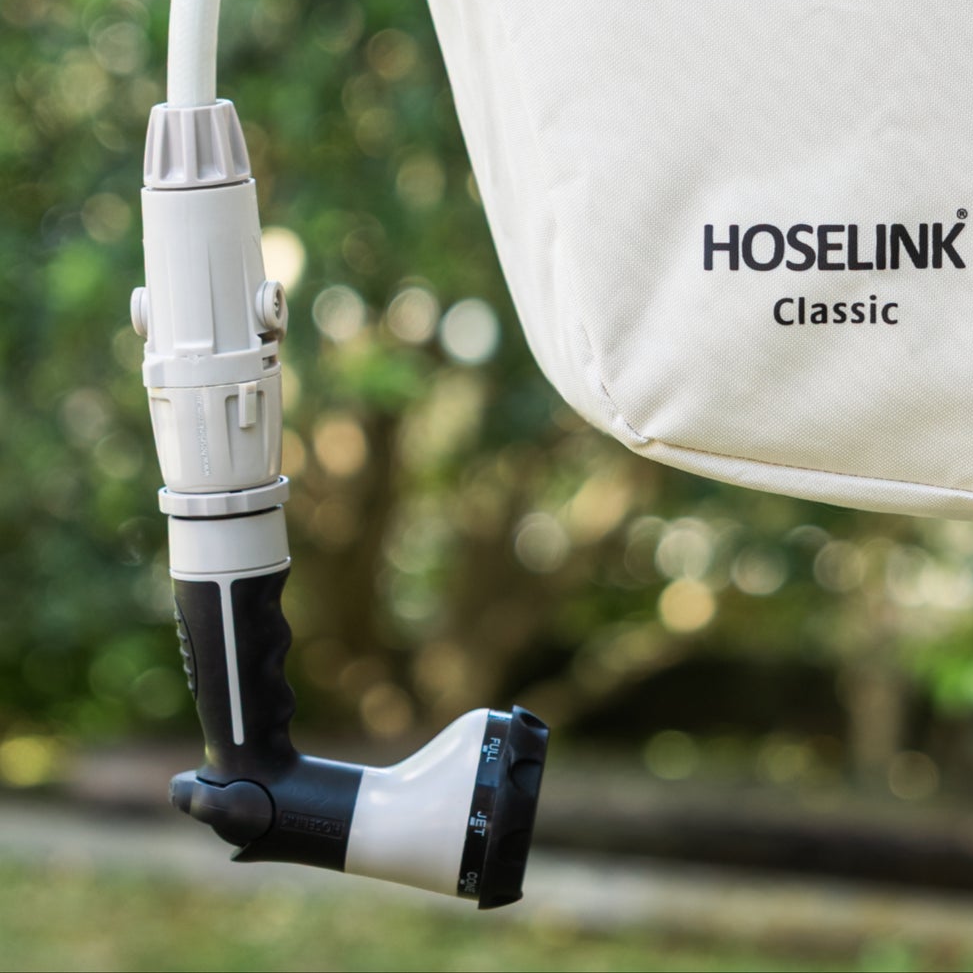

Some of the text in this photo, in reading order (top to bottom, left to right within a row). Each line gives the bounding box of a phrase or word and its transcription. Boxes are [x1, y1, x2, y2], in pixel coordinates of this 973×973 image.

[773, 294, 899, 326] Classic
[486, 737, 501, 763] FULL
[474, 811, 487, 837] JET
